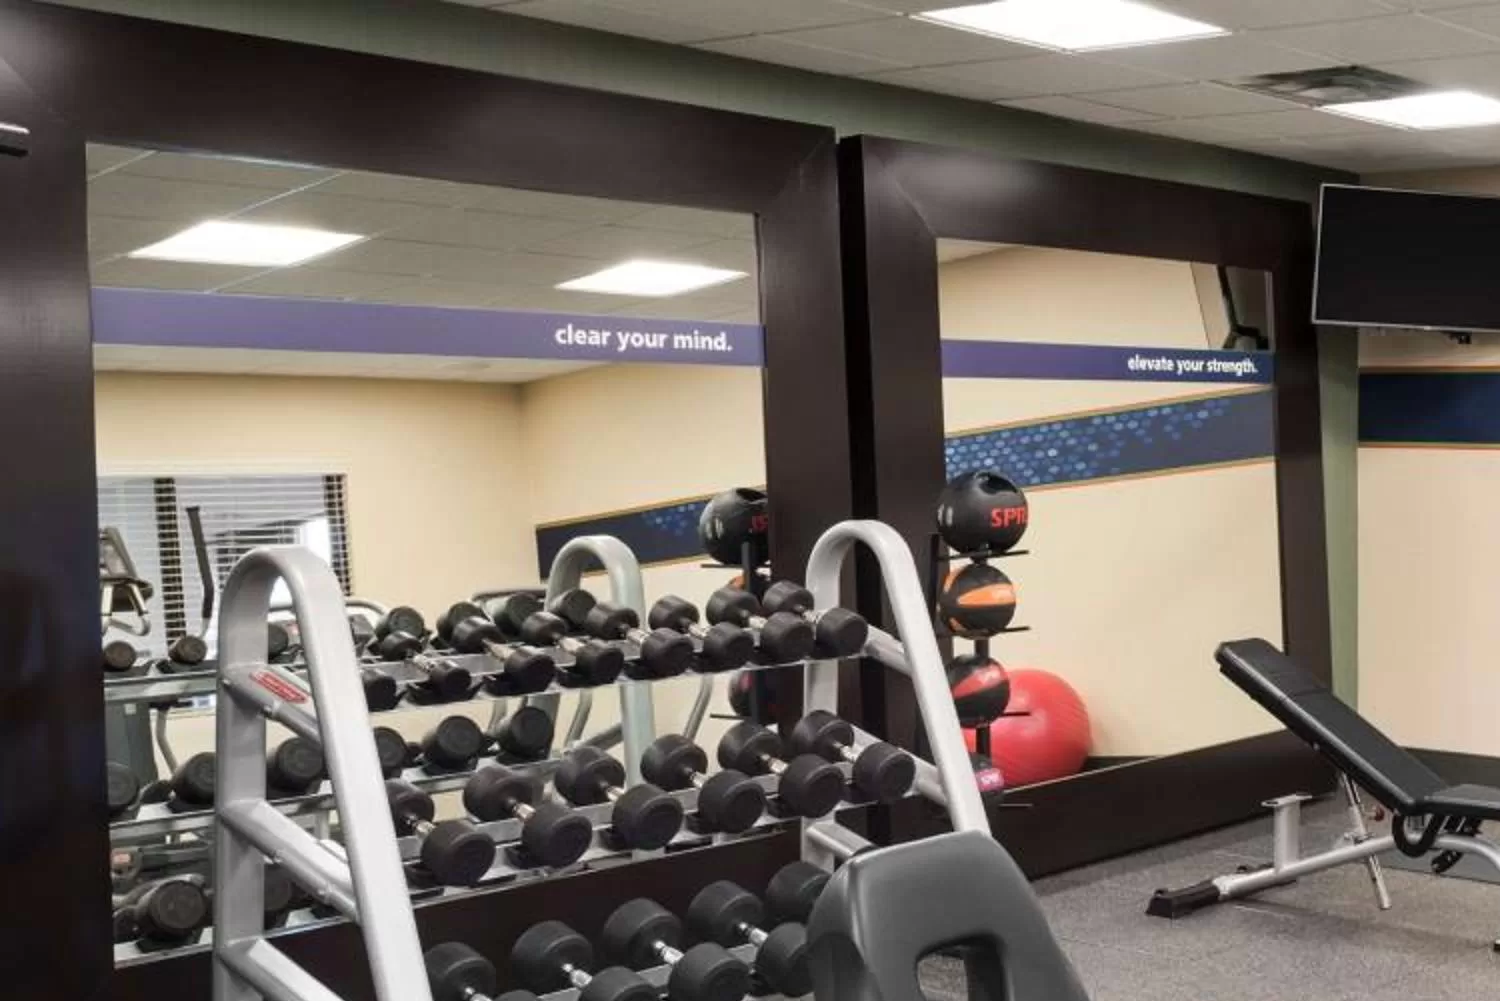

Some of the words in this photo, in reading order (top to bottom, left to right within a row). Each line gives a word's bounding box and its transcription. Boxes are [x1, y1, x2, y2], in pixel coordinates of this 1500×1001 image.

[555, 323, 611, 346] clear
[616, 330, 669, 352] your
[673, 329, 733, 352] mind.
[1127, 354, 1174, 372] elevate
[1175, 358, 1205, 376] your
[1207, 357, 1259, 377] strength.
